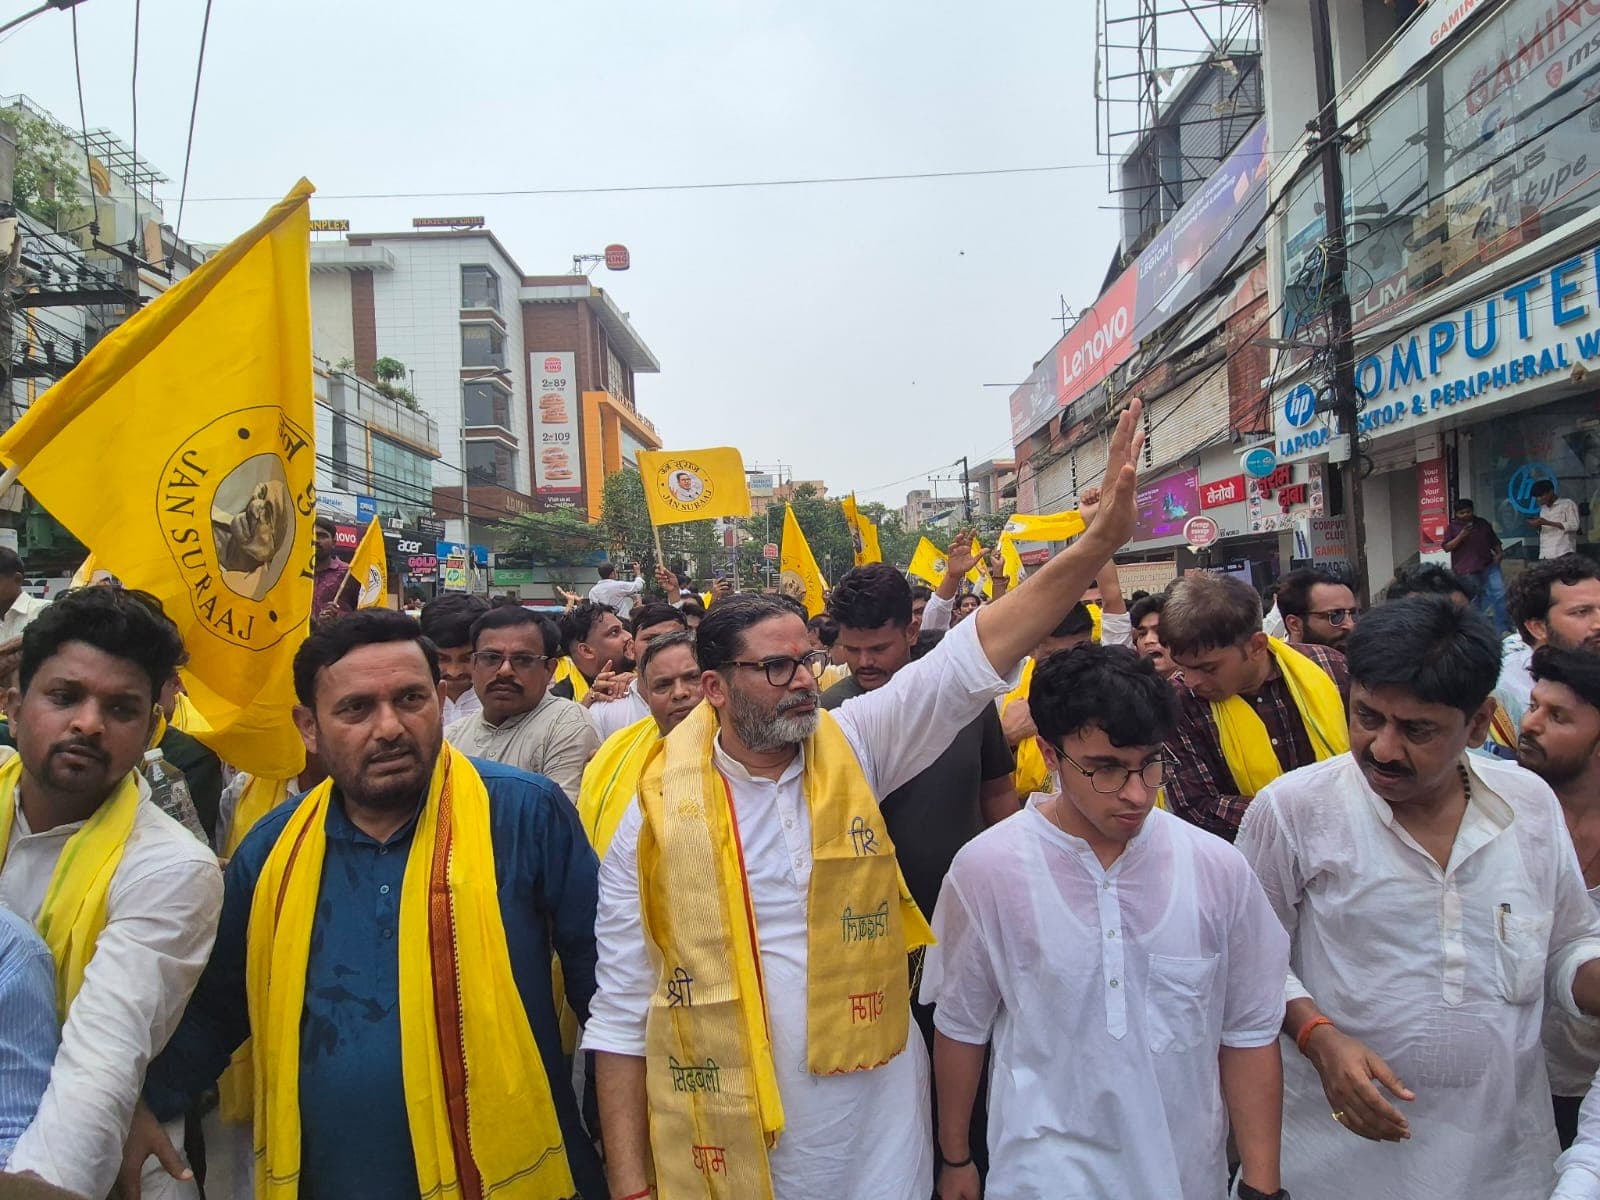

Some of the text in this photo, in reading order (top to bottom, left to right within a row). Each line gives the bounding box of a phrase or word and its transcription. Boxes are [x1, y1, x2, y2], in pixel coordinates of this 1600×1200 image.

[1481, 143, 1546, 202] ASUS
[1524, 153, 1587, 206] type
[1139, 240, 1170, 279] LEGION
[1355, 247, 1600, 400] OMPUTE
[1062, 306, 1128, 385] Lenovo
[1411, 394, 1425, 416] &
[1431, 343, 1570, 409] PERIPHERAL
[555, 432, 570, 442] 109
[662, 489, 712, 511] JAN SURAAJ
[1206, 481, 1236, 505] लेनोवो
[1420, 496, 1445, 505] Choice
[1424, 488, 1441, 497] Your
[165, 449, 255, 641] JAN SURAAJ
[397, 539, 423, 553] acer
[407, 556, 437, 568] GOLD
[666, 966, 694, 1008] श्री
